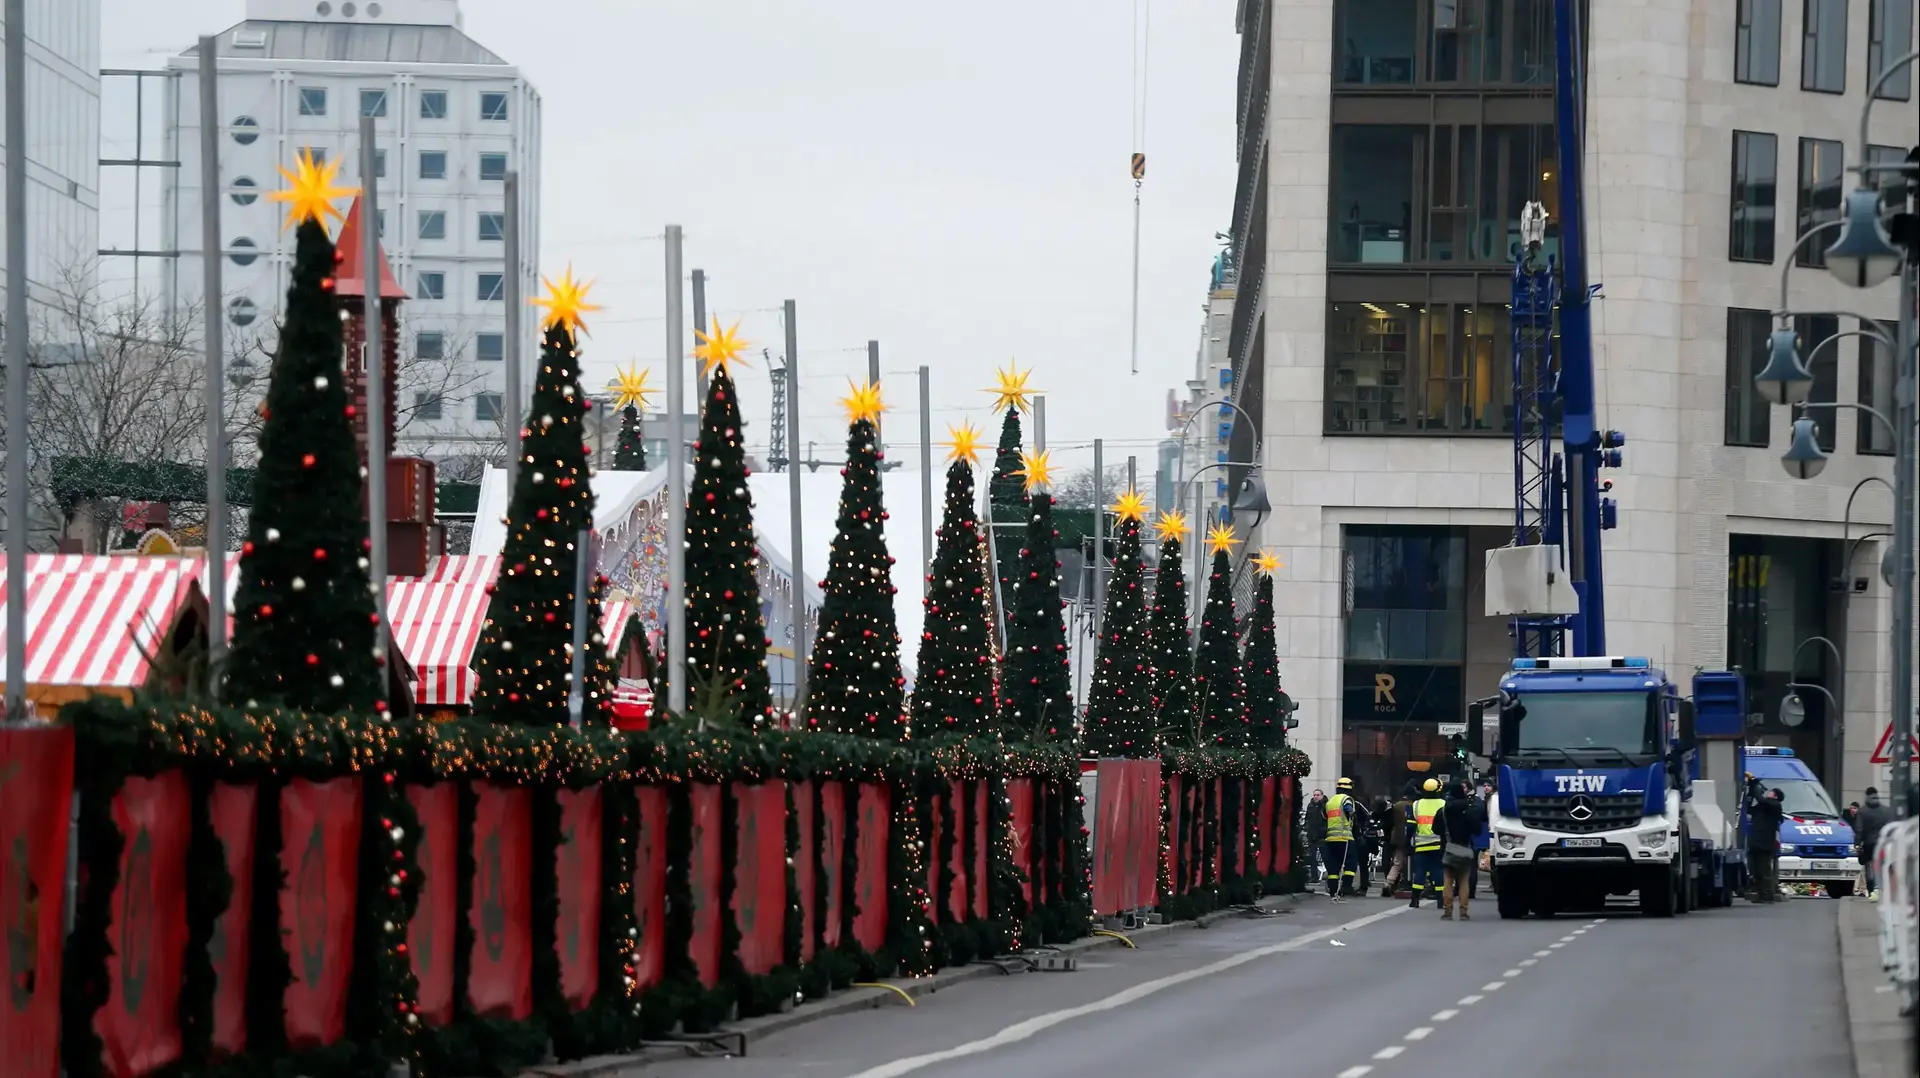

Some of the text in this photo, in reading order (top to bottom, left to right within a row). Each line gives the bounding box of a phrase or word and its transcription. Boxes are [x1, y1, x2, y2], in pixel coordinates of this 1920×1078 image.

[1375, 674, 1396, 703] R
[1555, 775, 1607, 792] THW
[1795, 826, 1833, 835] THW
